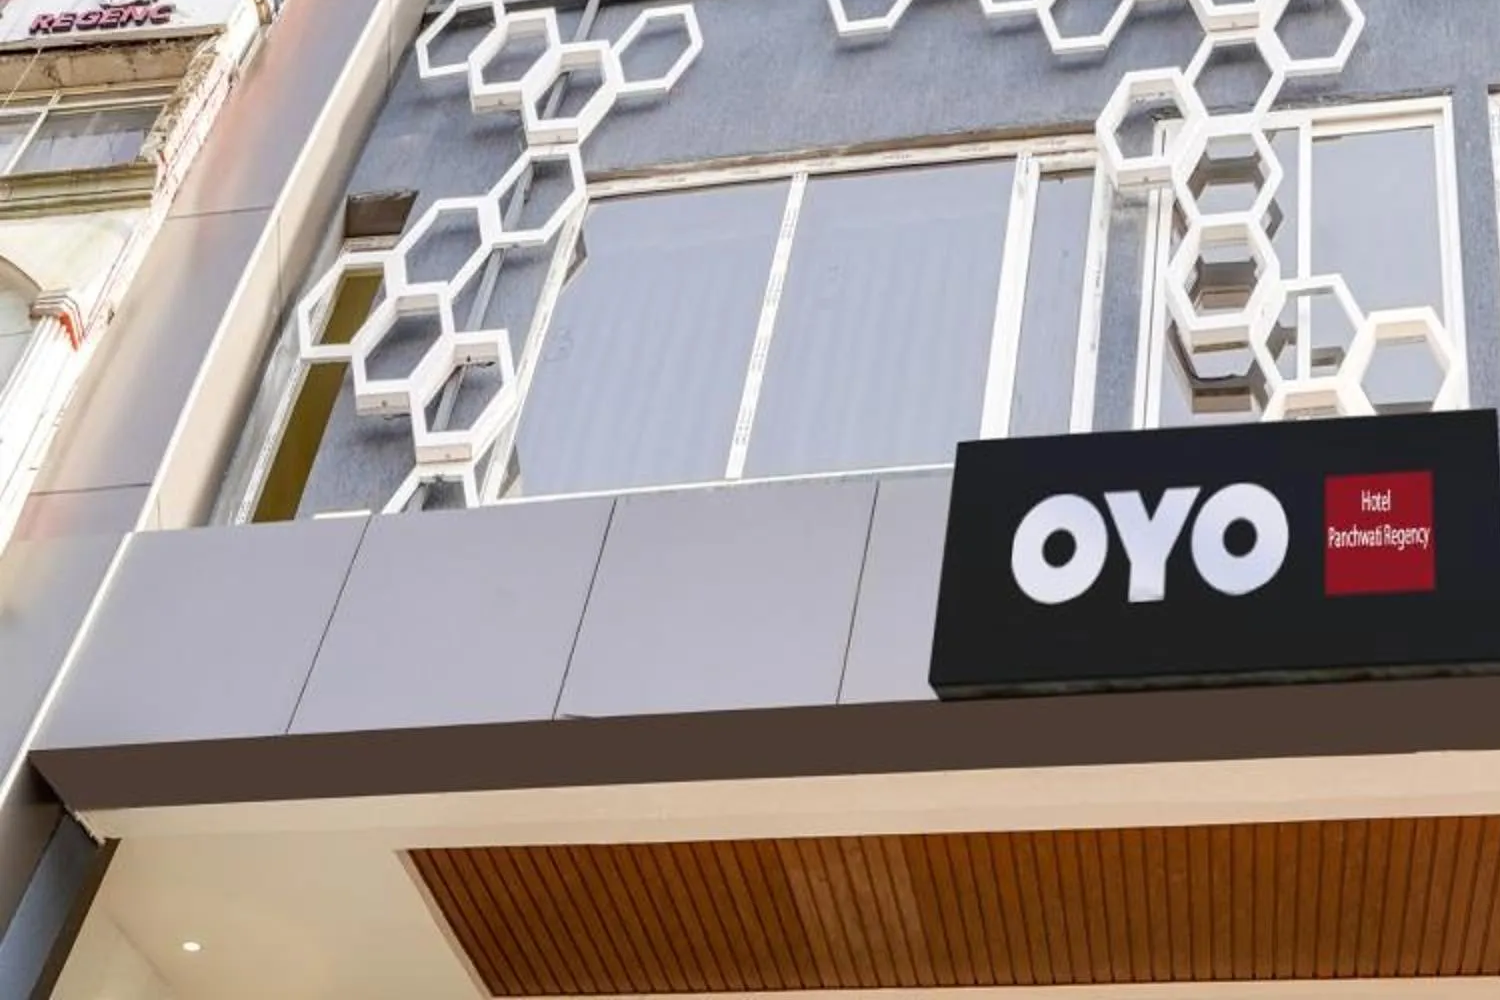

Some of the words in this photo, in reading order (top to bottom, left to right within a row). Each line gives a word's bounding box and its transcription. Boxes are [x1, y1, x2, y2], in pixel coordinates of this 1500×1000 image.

[1360, 488, 1392, 512] Hotel
[1011, 482, 1290, 605] OYO
[1327, 523, 1383, 549] Panchwati
[1383, 523, 1431, 551] Regency
